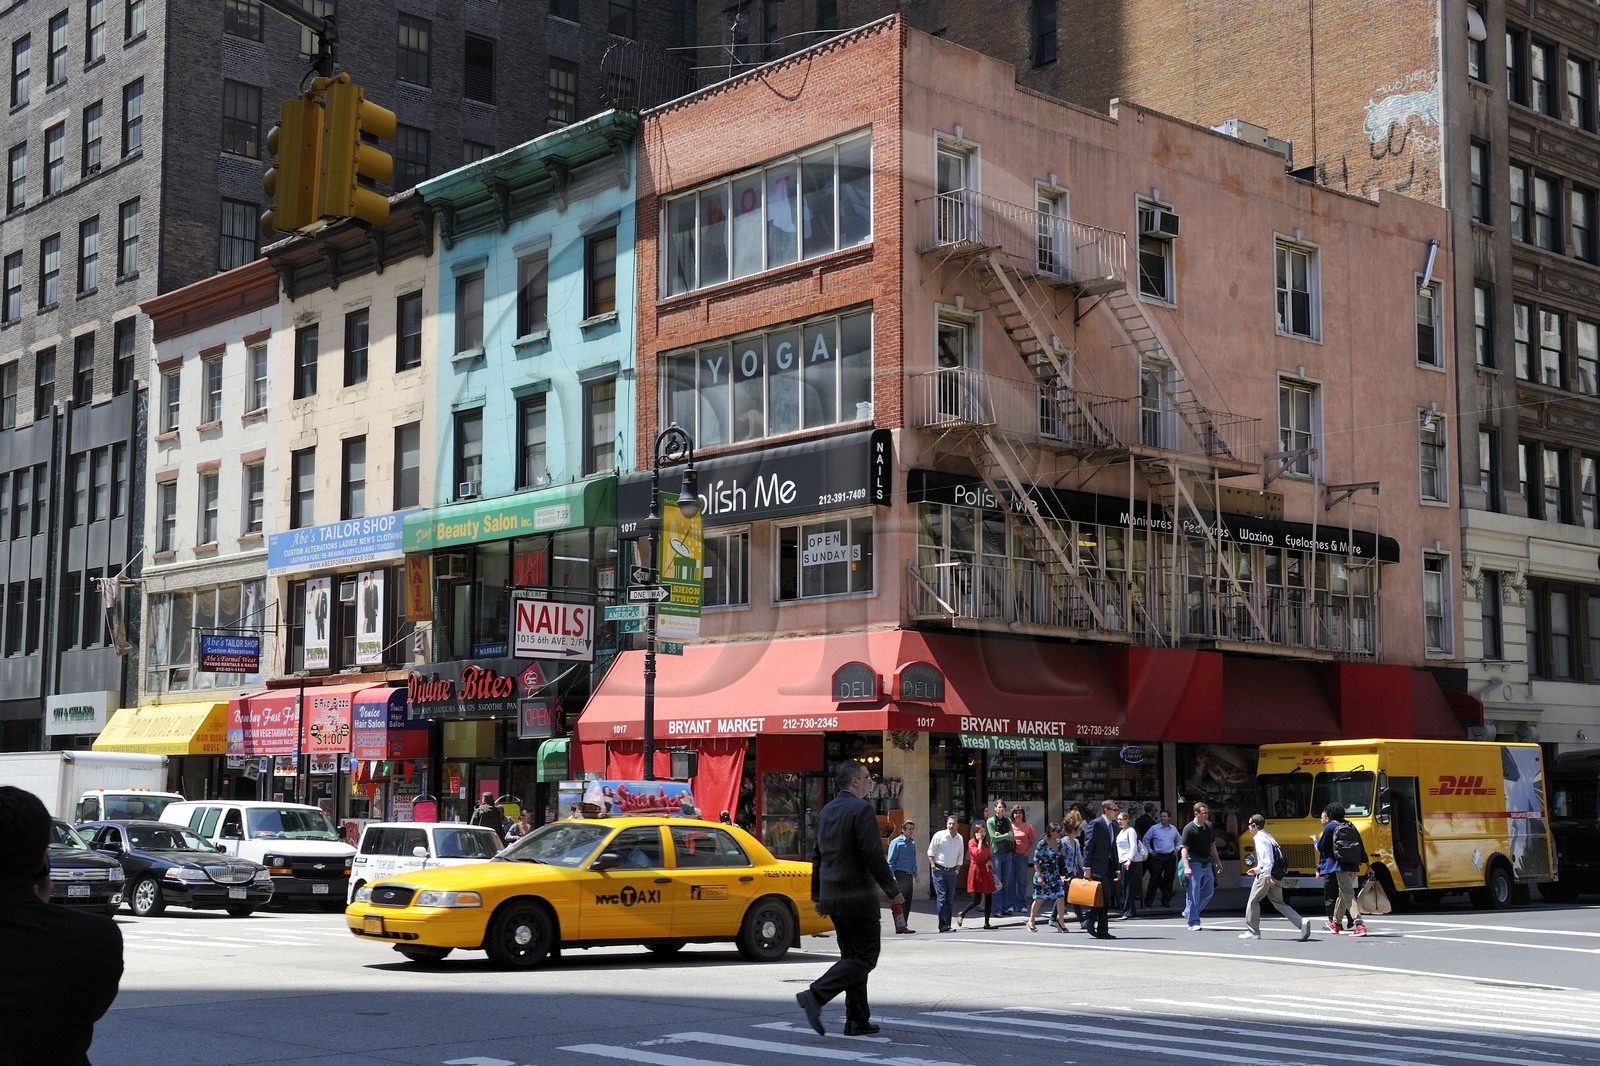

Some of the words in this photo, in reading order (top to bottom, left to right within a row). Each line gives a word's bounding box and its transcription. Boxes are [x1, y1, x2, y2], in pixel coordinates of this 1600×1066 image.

[706, 175, 791, 225] HOT
[707, 333, 829, 384] YOGA
[875, 442, 884, 500] NAILS
[698, 479, 747, 515] olish
[754, 473, 797, 508] Me
[818, 488, 867, 506] 212-391-7409
[291, 529, 316, 548] Abe's
[319, 521, 360, 542] TAILOR
[363, 515, 396, 535] SHOP
[437, 518, 480, 541] Beauty
[483, 513, 518, 534] Salon
[521, 516, 532, 528] Inc.
[620, 522, 637, 533] 1017
[283, 549, 303, 557] CUSTOM
[304, 541, 337, 554] ALTERATIONS
[338, 539, 358, 549] LADIES'
[359, 535, 375, 545] MEN'S
[376, 530, 403, 542] CLOTHING
[808, 533, 841, 548] OPEN
[1239, 528, 1274, 546] Waxing
[1285, 534, 1329, 551] Eyelashes
[1330, 540, 1338, 551] &
[636, 572, 647, 580] ONE
[411, 558, 424, 611] NAIL
[671, 586, 700, 595] SHION
[651, 590, 665, 598] WAY
[671, 595, 700, 604] STRICT
[517, 603, 584, 637] NAILS
[608, 610, 640, 619] AMERICAS
[624, 621, 631, 631] 6
[203, 637, 224, 647] Abe's
[225, 639, 243, 648] TAILOR
[244, 640, 258, 648] SHOP
[517, 634, 535, 643] 1015
[537, 635, 549, 645] 6th
[551, 637, 568, 645] AVE.
[479, 647, 502, 655] MASSAGE
[668, 643, 677, 653] 38
[406, 670, 452, 704] Divine
[457, 665, 513, 700] Bites
[841, 680, 874, 699] DELI
[902, 680, 937, 699] DELI
[359, 705, 381, 718] Venice
[458, 704, 475, 712] SALADS
[478, 703, 503, 711] SMOOTHIE
[555, 697, 564, 733] NAILS
[234, 709, 261, 727] Bombay
[262, 707, 281, 726] Fast
[354, 719, 367, 728] Hair
[367, 719, 386, 728] Salon
[388, 720, 405, 728] Salon
[524, 708, 553, 728] OPEN
[668, 719, 711, 734] BRYANT
[717, 717, 765, 733] MARKET
[782, 716, 838, 729] 212-730-2345
[916, 717, 935, 728] 1017
[260, 728, 287, 738] VEGETARIAN
[613, 725, 627, 734] 1017
[960, 717, 1010, 732] BRYANT
[1017, 719, 1066, 735] MARKET
[1076, 725, 1120, 736] 212-730-2345
[317, 733, 342, 745] $1.00
[961, 734, 991, 749] Fresh
[991, 735, 1027, 751] Tossed
[1028, 737, 1057, 752] Salad
[1058, 738, 1075, 752] Bar
[312, 762, 335, 771] $1.00
[1301, 758, 1332, 766] DHL
[1438, 775, 1488, 796] DHL
[595, 895, 619, 905] NYC
[621, 888, 661, 906] TAXI
